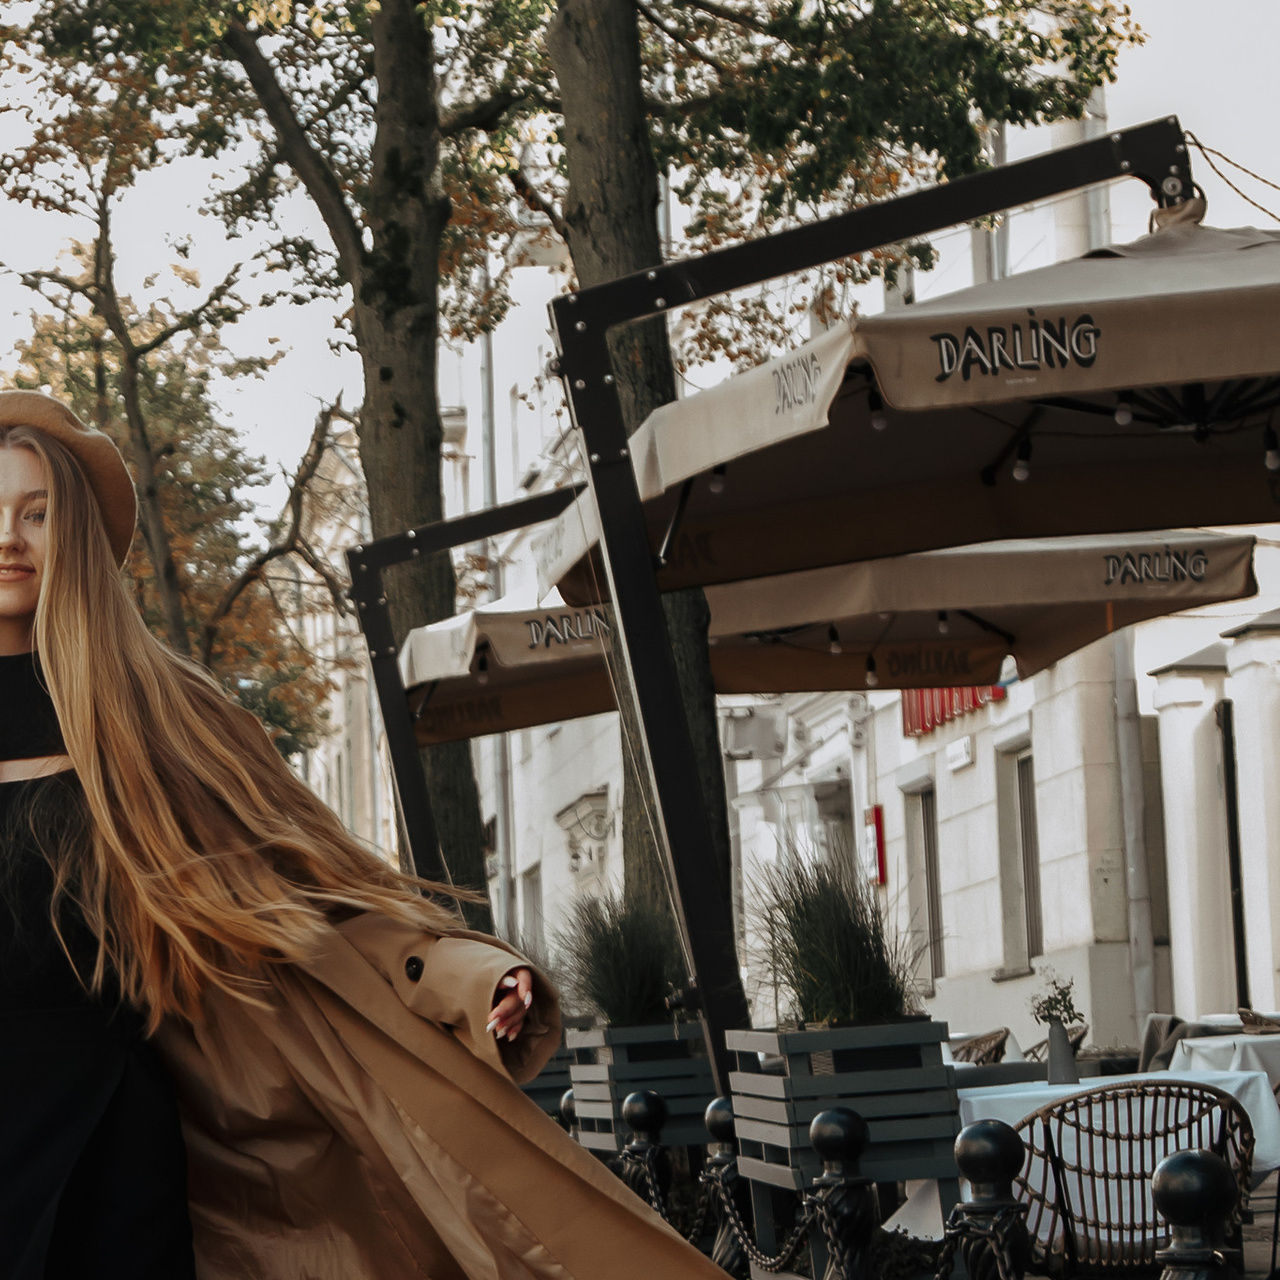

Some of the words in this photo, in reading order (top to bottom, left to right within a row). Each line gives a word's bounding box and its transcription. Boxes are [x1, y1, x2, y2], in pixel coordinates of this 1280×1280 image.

[930, 308, 1101, 382] DARLING
[1103, 544, 1209, 585] DARLING
[525, 608, 610, 649] DARLIN
